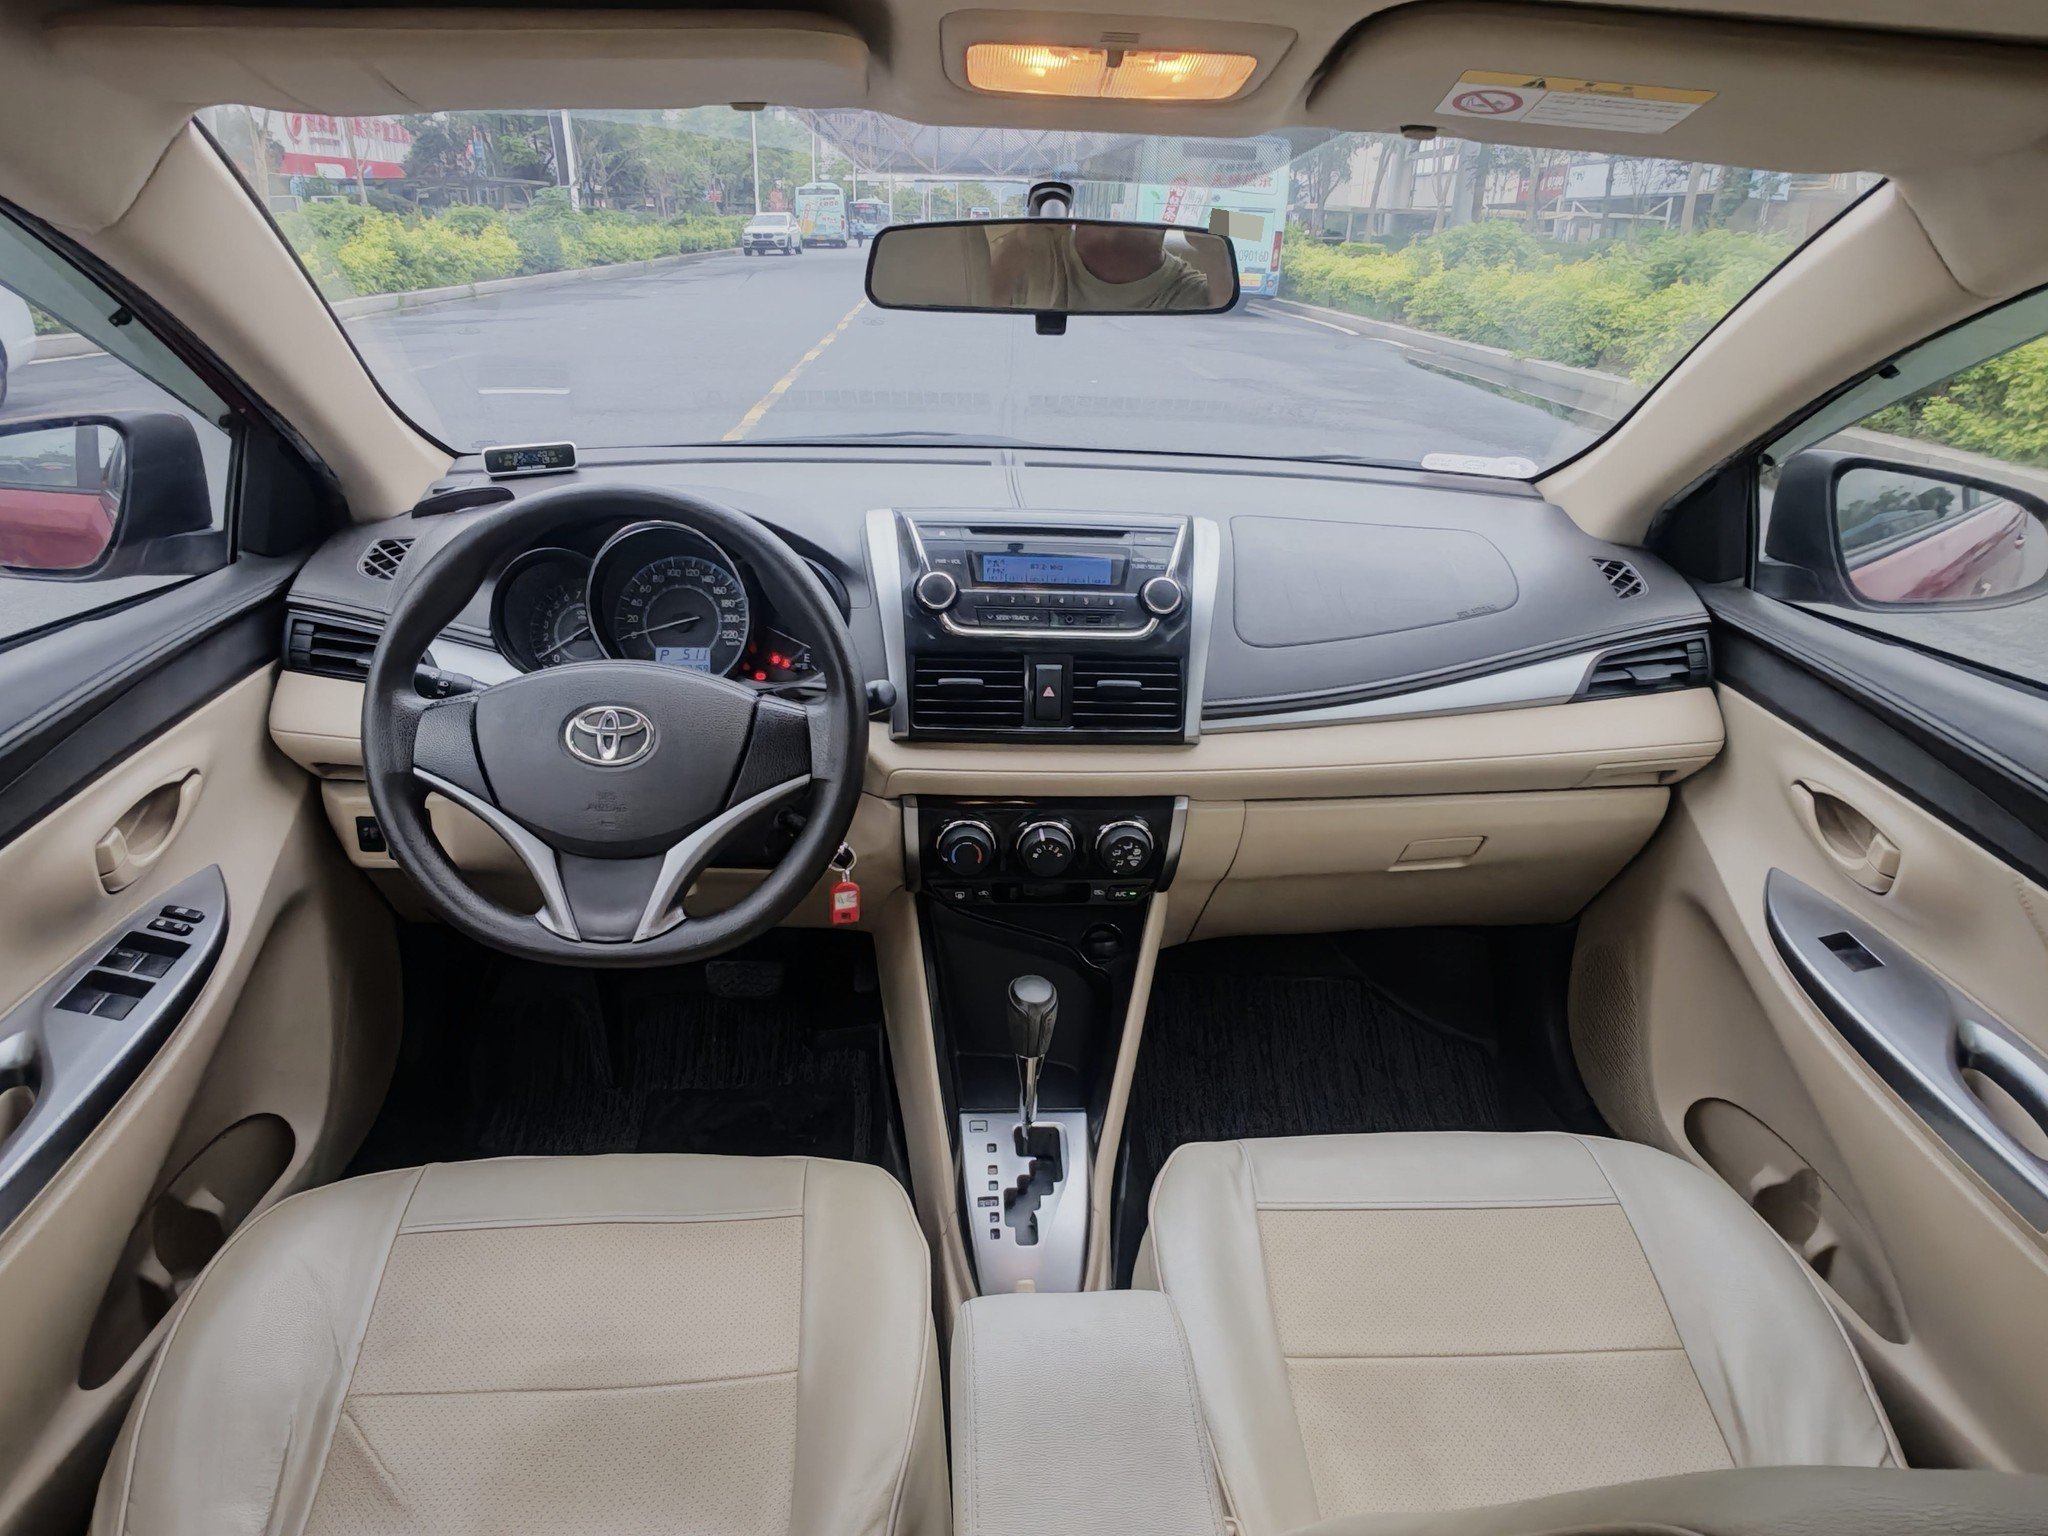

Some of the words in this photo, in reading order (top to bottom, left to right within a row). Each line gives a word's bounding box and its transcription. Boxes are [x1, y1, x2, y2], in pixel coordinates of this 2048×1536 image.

[685, 569, 700, 577] 120
[640, 585, 652, 593] 60
[627, 614, 639, 623] 20
[723, 614, 740, 624] 200
[722, 629, 739, 639] 220
[553, 654, 560, 663] 0
[660, 649, 670, 661] P
[803, 653, 811, 662] E
